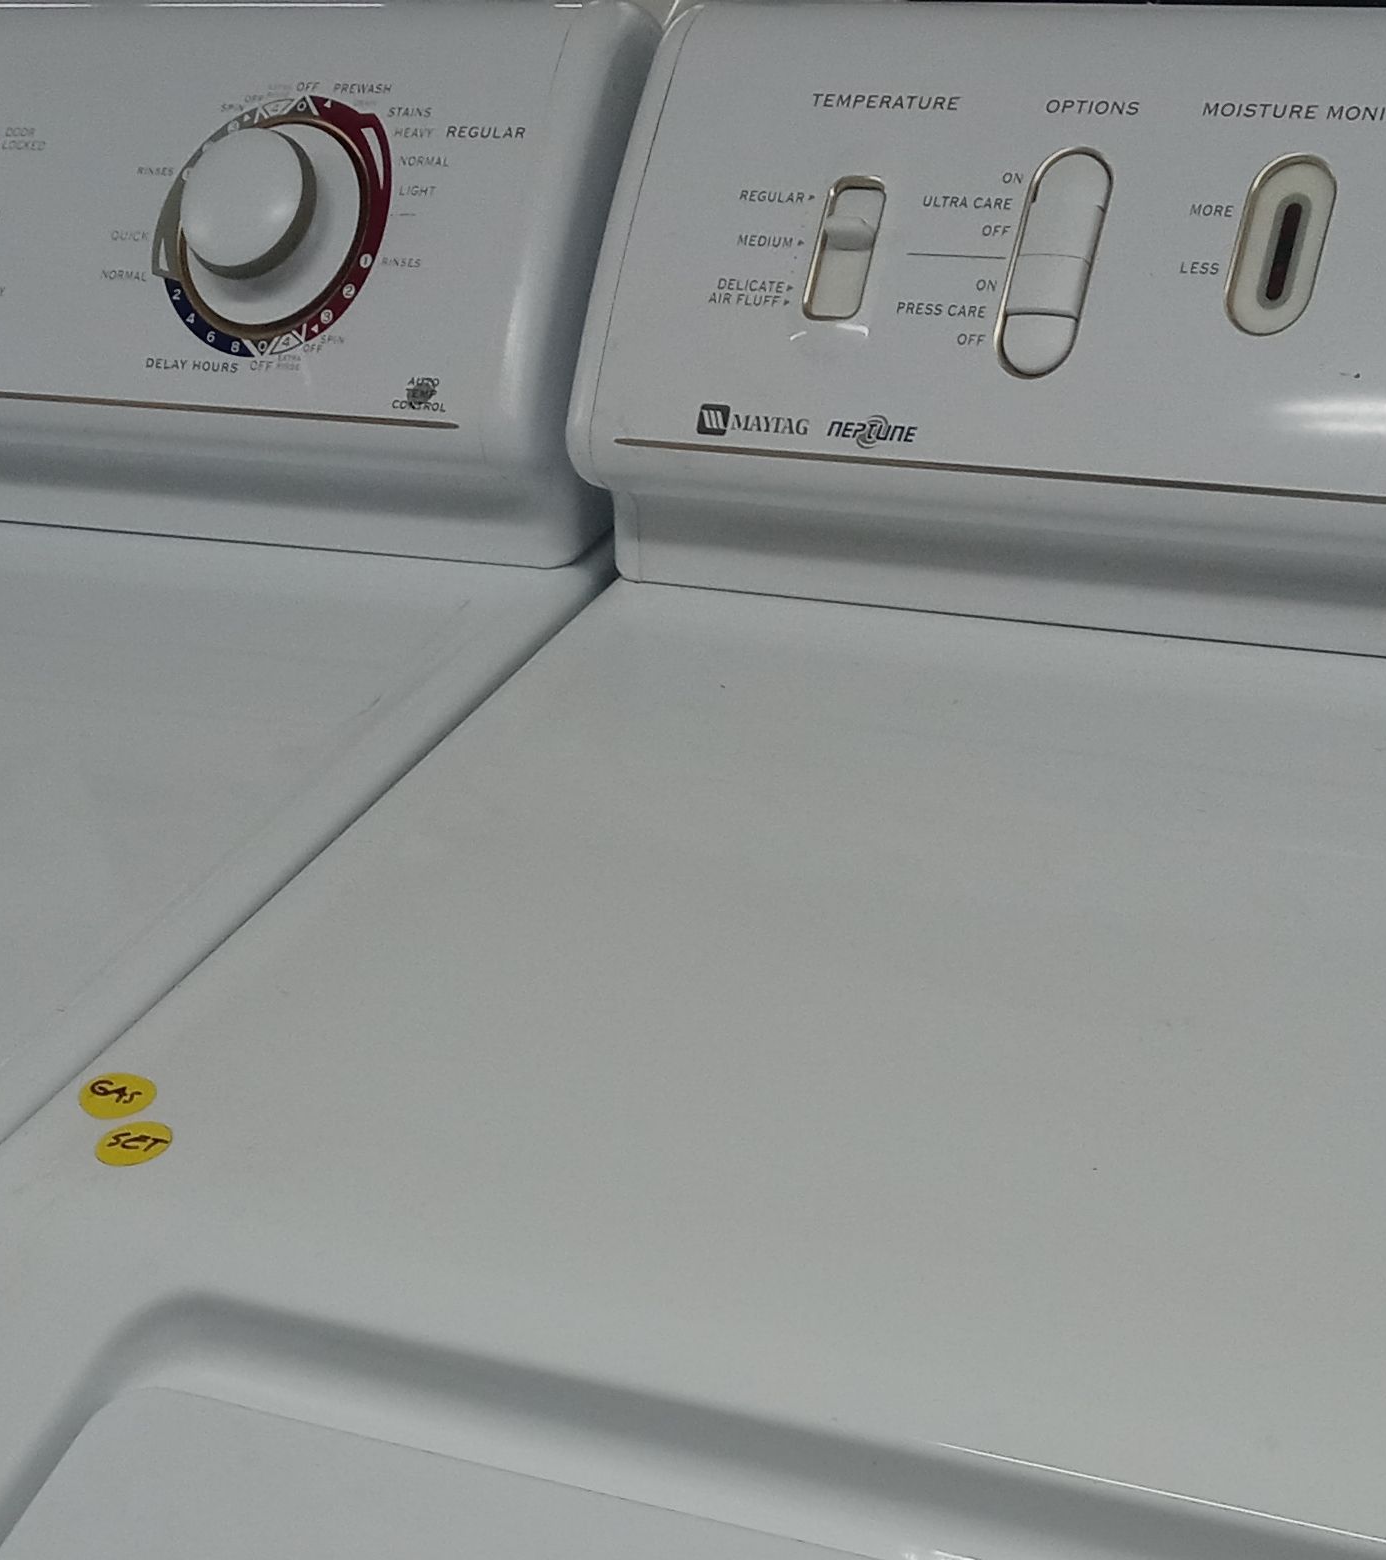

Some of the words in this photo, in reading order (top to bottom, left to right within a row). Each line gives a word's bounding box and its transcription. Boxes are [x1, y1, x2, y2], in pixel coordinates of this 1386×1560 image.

[296, 81, 321, 92] OFF
[333, 82, 393, 95] PREWASH
[812, 93, 961, 112] TEMPERATURE
[1044, 99, 1141, 117] OPTIONS
[386, 106, 433, 119] STAINS
[1201, 101, 1319, 121] MOISTURE
[394, 127, 435, 139] HEAVY
[445, 125, 527, 142] REGULAR
[398, 155, 449, 168] NORMAL
[136, 166, 174, 177] RINSES
[1001, 171, 1024, 185] ON
[398, 185, 438, 197] LIGHT
[738, 189, 805, 204] REGULAR
[921, 195, 968, 210] ULTRA
[970, 196, 1013, 211] CARE
[1189, 203, 1234, 218] MORE
[110, 230, 151, 243] QUICK
[981, 224, 1011, 238] OFF
[736, 234, 794, 249] MEDIUM
[380, 257, 422, 268] RINSES
[1179, 261, 1220, 276] LESS
[100, 269, 148, 282] NORMAL
[716, 277, 786, 294] DELICATE
[975, 278, 998, 292] ON
[171, 288, 182, 301] 2
[708, 292, 733, 306] AIR
[736, 293, 782, 308] FLUFF
[896, 301, 946, 317] PRESS
[947, 303, 986, 319] CARE
[185, 312, 196, 324] 4
[206, 331, 216, 343] 6
[956, 332, 986, 347] OFF
[230, 341, 241, 353] 8
[145, 356, 189, 371] DELAY
[192, 360, 240, 374] HOURS
[250, 360, 273, 372] OFF
[731, 414, 810, 436] MAYTAG
[106, 1132, 169, 1152] SET
